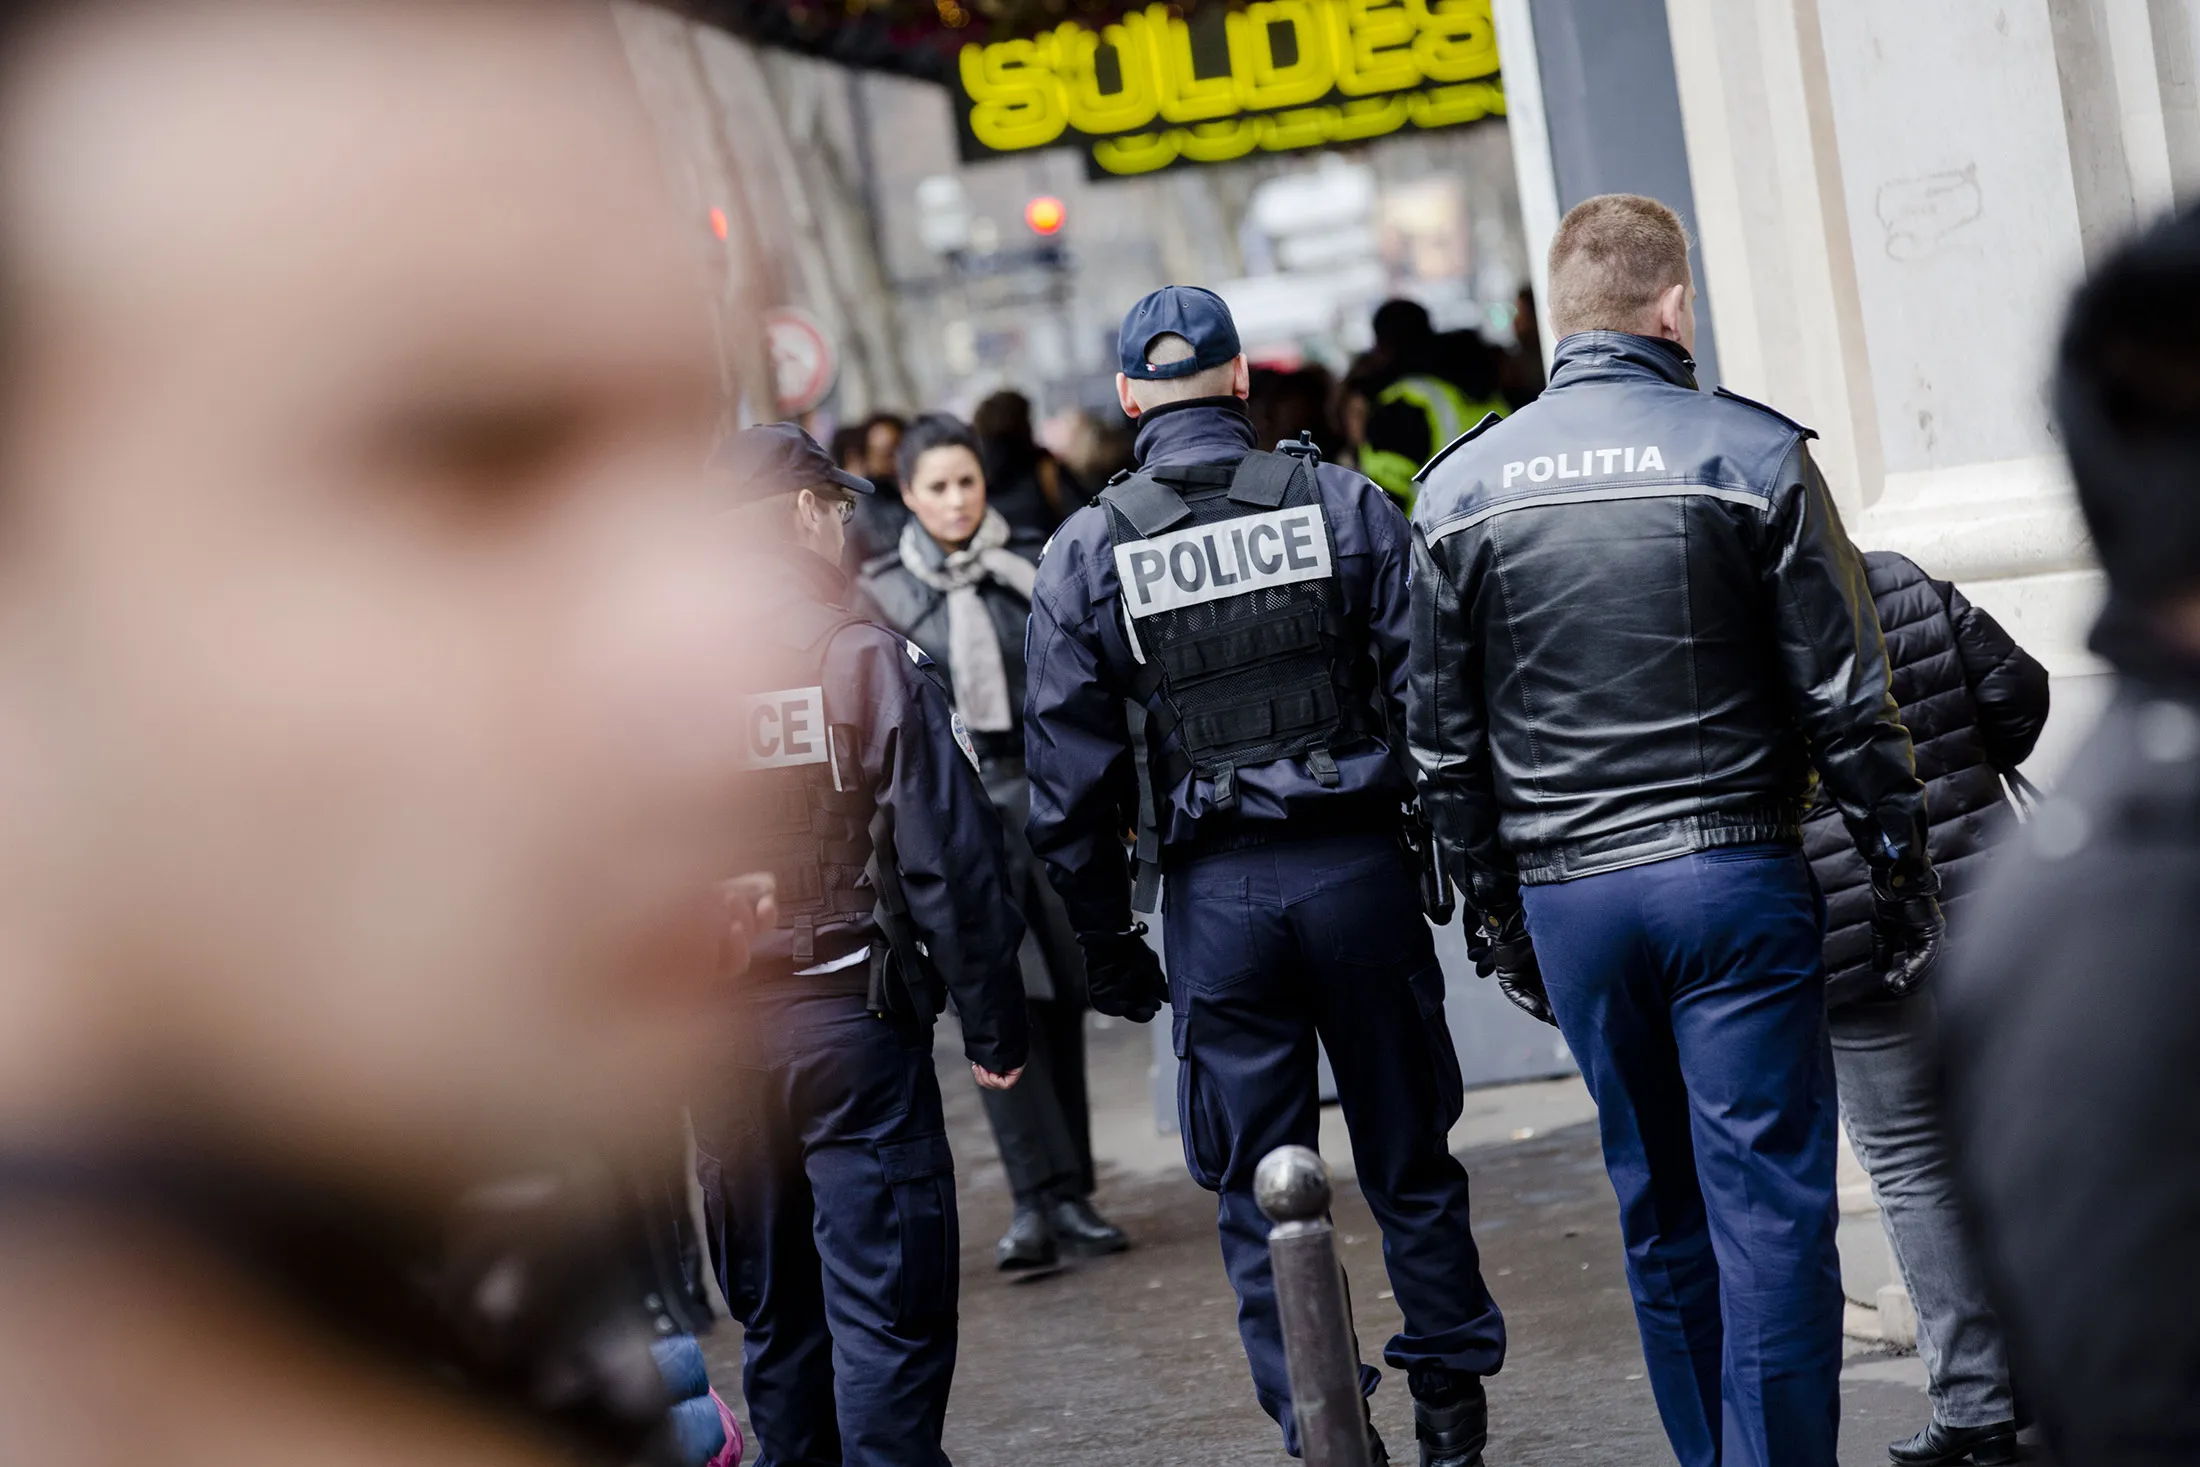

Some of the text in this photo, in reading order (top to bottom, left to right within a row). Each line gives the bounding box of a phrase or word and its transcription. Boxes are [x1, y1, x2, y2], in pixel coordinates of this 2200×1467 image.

[959, 0, 1501, 150] SOLDES
[1503, 446, 1665, 488] POLITIA
[1130, 516, 1318, 605] POLICE
[743, 699, 813, 758] CE
